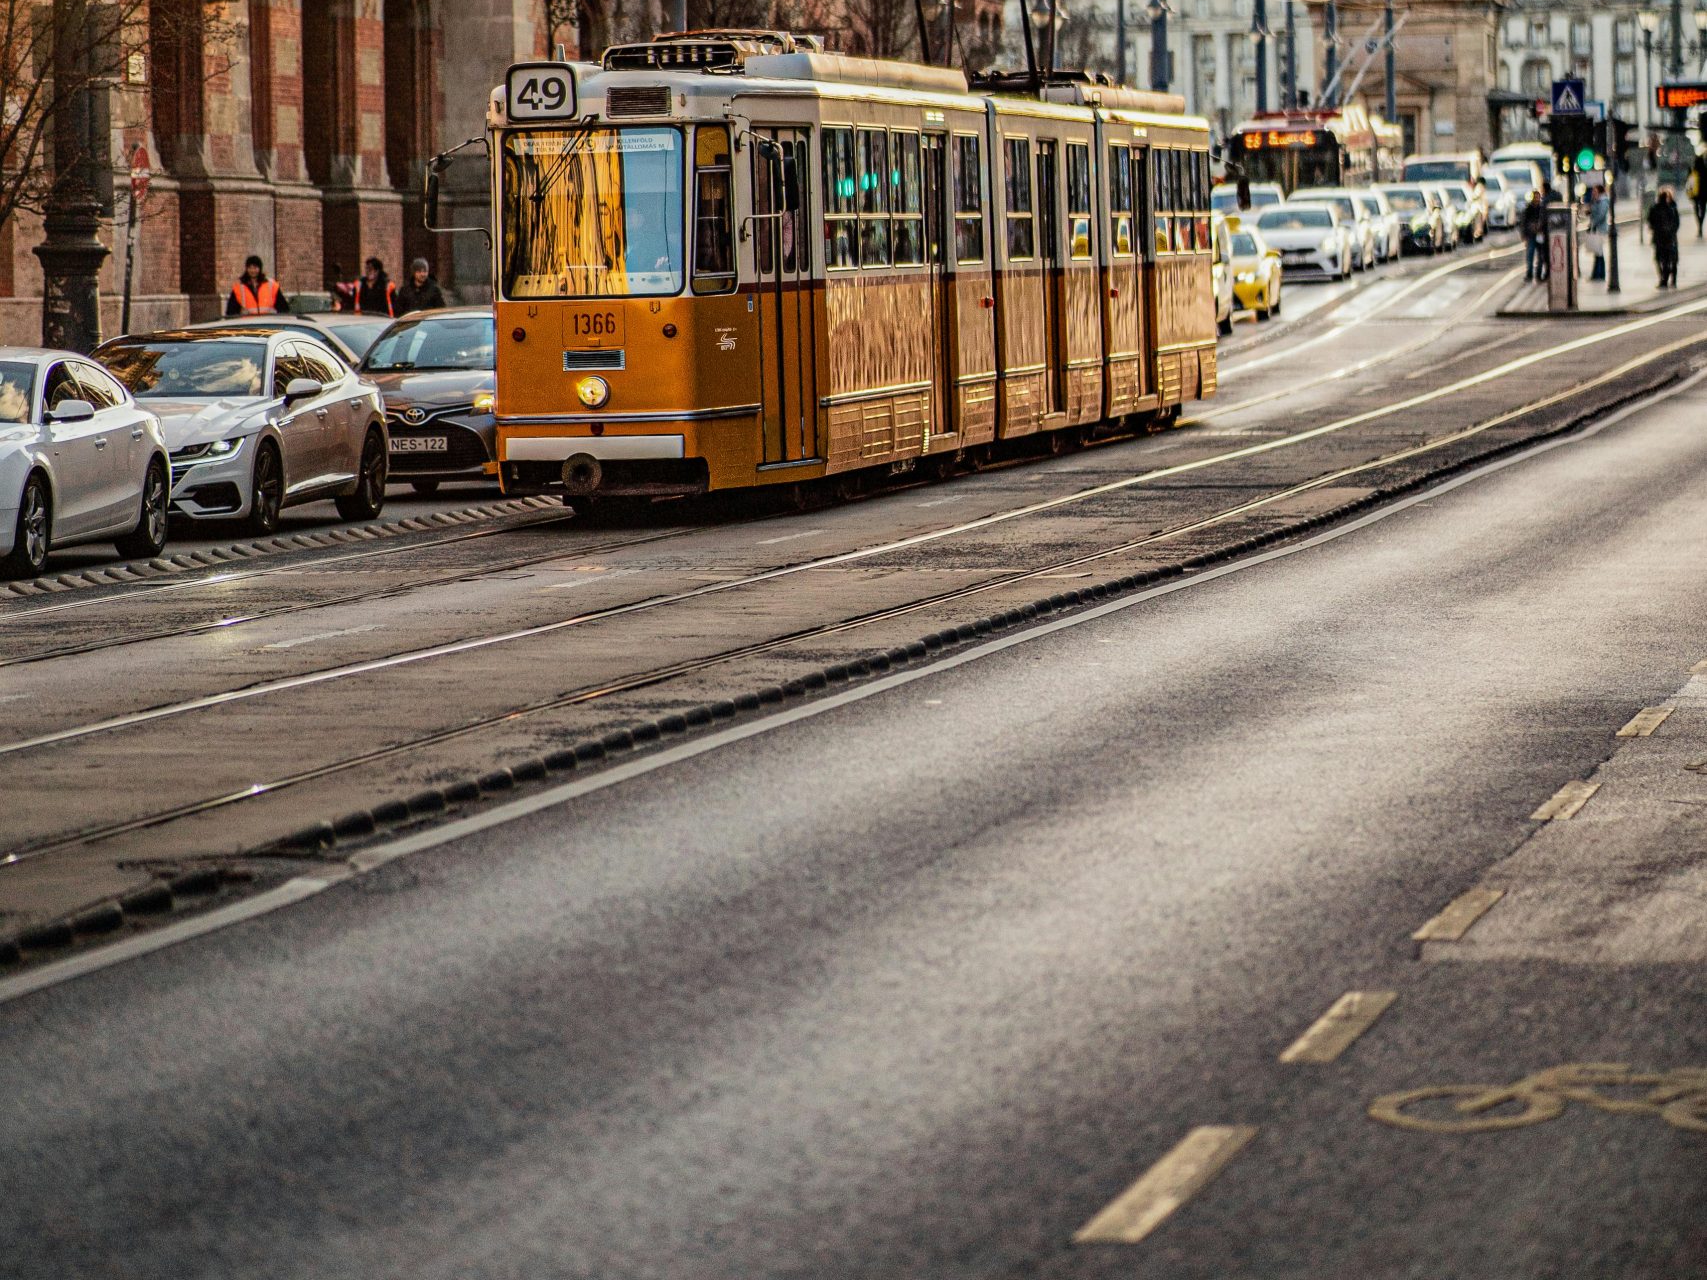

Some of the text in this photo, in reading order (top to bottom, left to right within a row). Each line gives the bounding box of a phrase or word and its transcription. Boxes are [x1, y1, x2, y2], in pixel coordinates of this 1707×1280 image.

[517, 77, 567, 111] 49
[573, 312, 616, 335] 1366
[391, 438, 445, 450] NES-122
